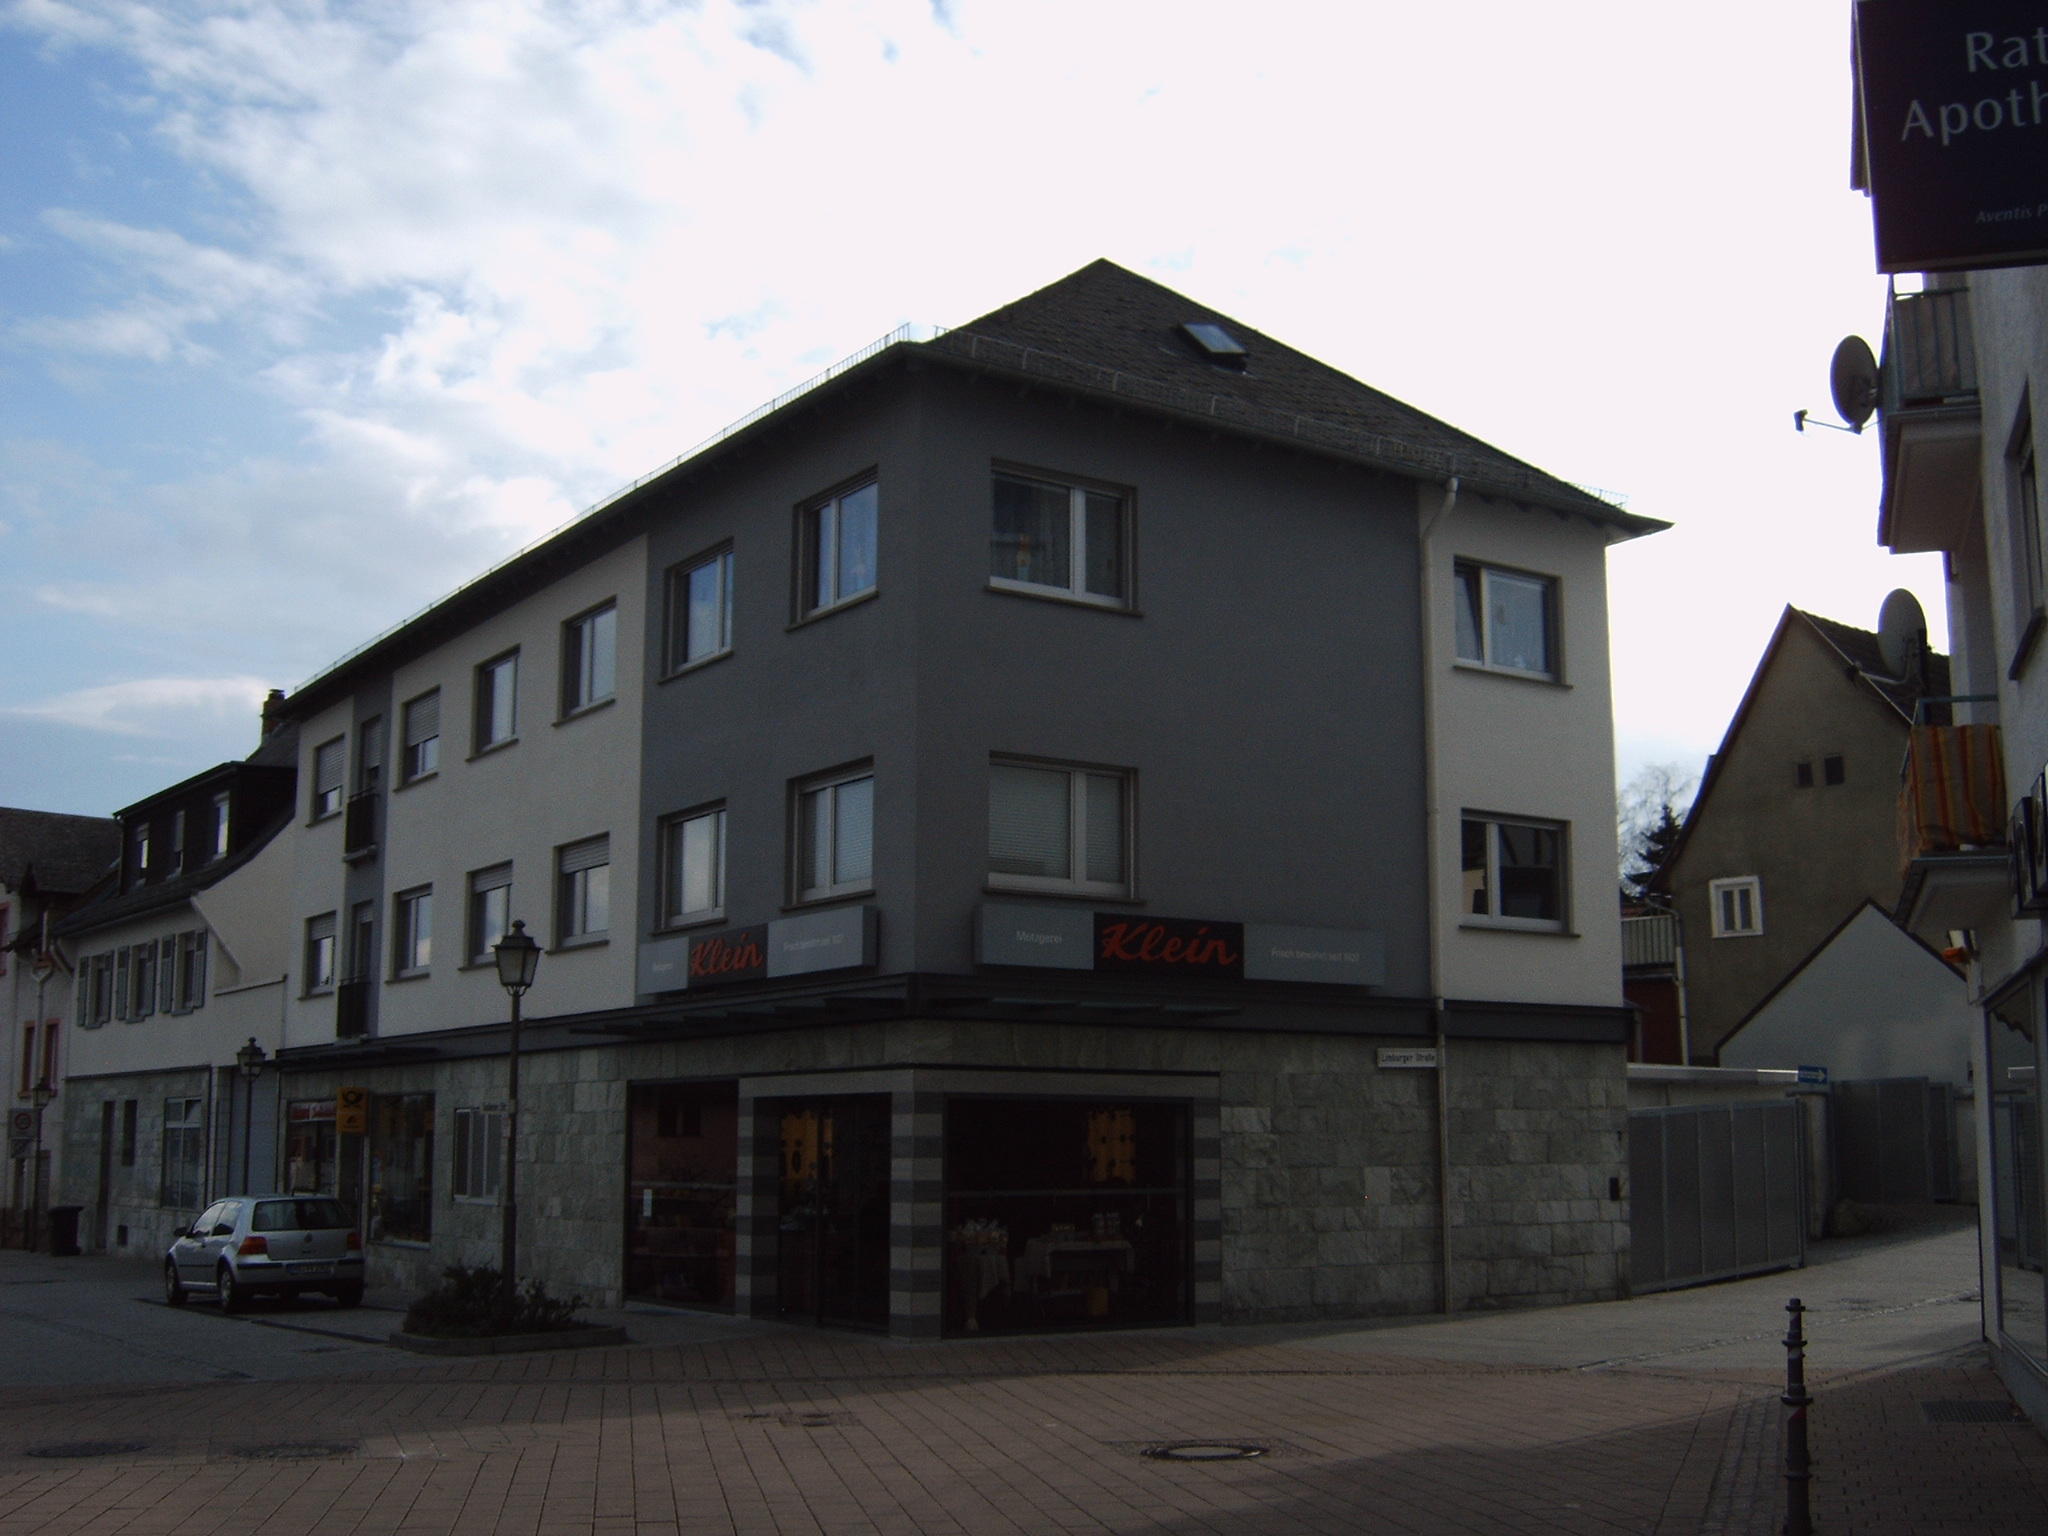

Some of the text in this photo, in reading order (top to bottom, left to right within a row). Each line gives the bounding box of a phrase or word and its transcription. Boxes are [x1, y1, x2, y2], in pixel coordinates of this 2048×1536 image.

[1965, 27, 2048, 73] Rat
[1975, 204, 2032, 224] Aventis
[690, 932, 764, 976] Klein
[1016, 930, 1062, 946] Metzgerei
[1101, 920, 1239, 966] Klein
